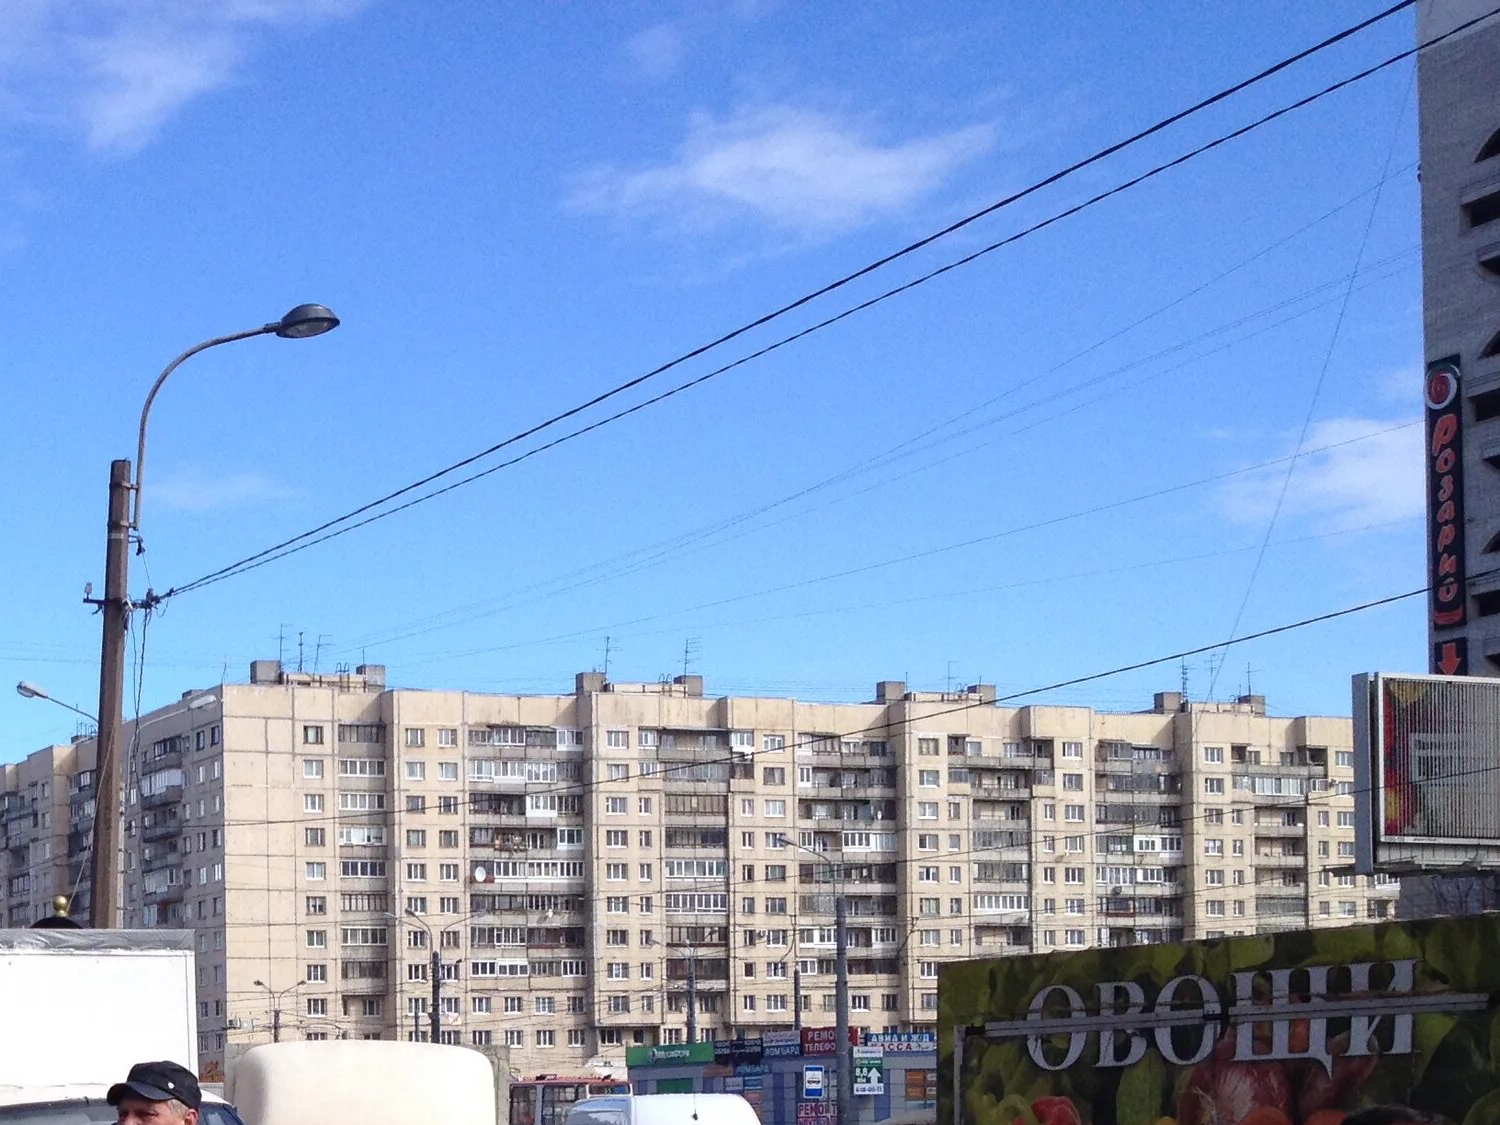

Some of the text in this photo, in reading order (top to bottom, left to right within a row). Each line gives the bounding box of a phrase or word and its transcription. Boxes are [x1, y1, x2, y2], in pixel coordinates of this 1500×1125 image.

[871, 1034, 898, 1042] АВИА
[901, 1034, 908, 1042] И
[1026, 958, 1421, 1079] ОВОЩИ
